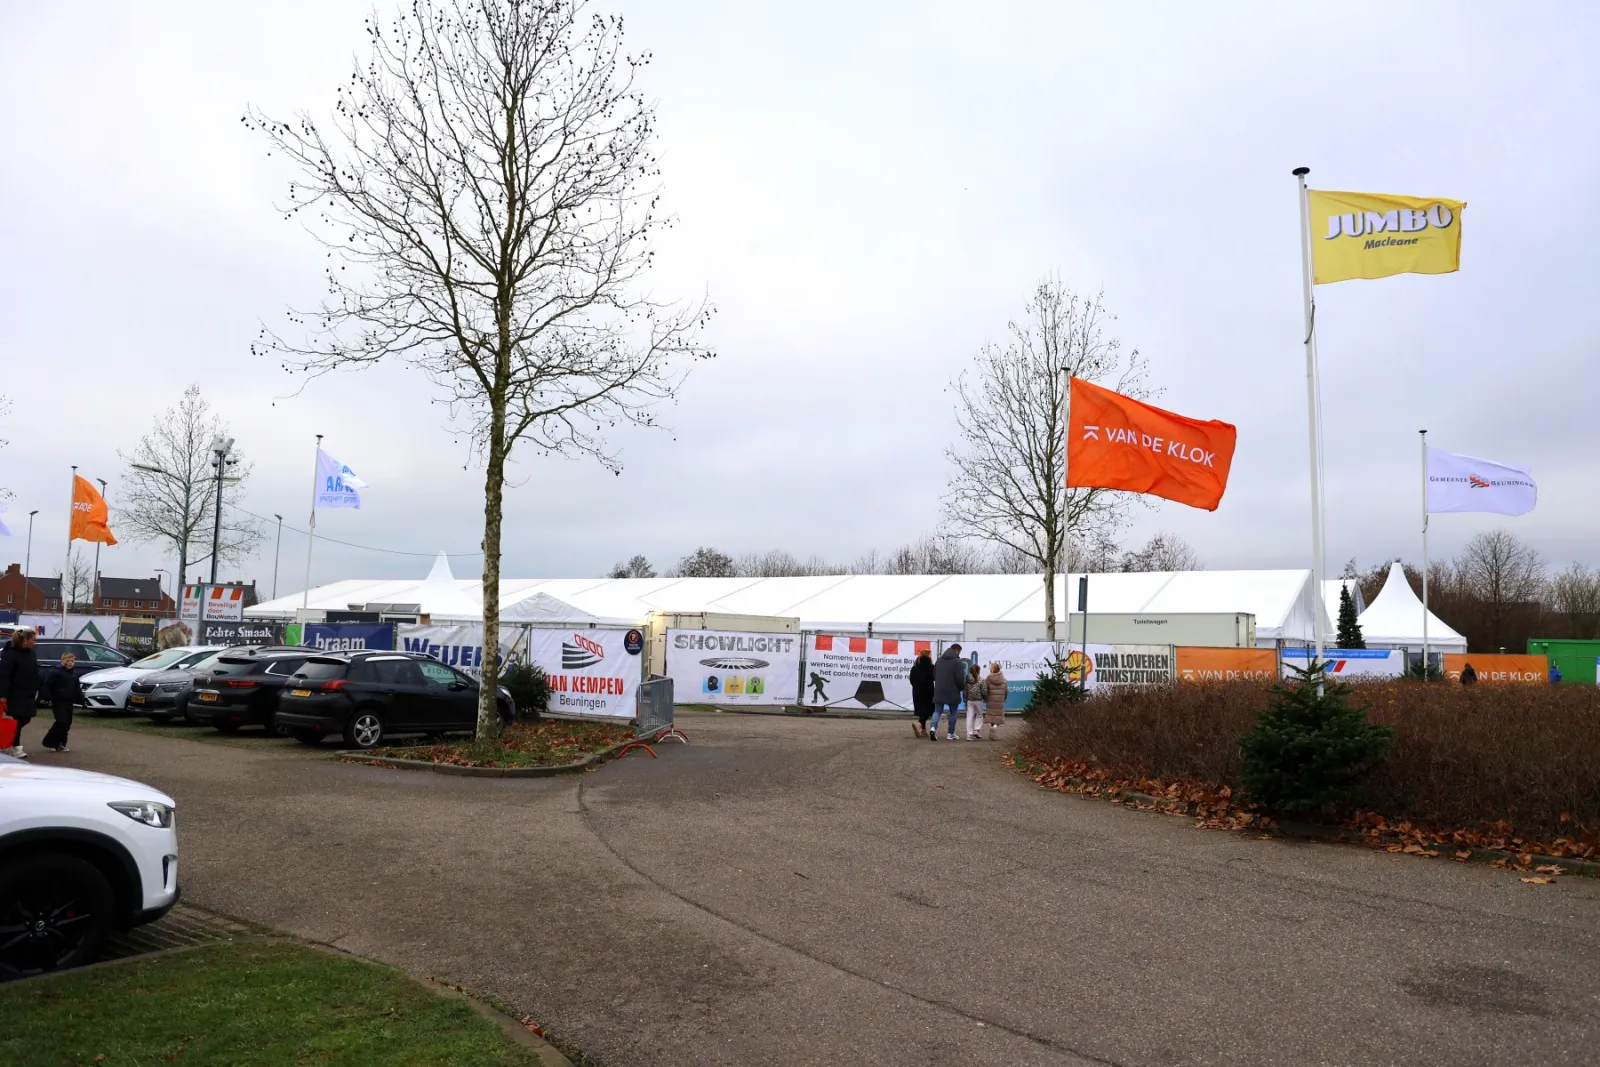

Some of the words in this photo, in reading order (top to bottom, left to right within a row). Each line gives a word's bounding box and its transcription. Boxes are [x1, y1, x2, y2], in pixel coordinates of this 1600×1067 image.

[1324, 203, 1453, 240] JUMBO
[1364, 237, 1418, 249] Macleane
[1106, 428, 1137, 444] VAN
[1142, 434, 1163, 452] DE
[1167, 441, 1215, 467] KLOK
[205, 626, 235, 638] Echte
[237, 626, 272, 638] Smaak
[315, 632, 366, 650] braam
[674, 634, 794, 653] SHOWLIGHT
[823, 653, 853, 662] Namens
[866, 656, 902, 664] Beuningse
[1095, 653, 1118, 668] VAN
[1121, 654, 1168, 669] LOVEREN
[840, 662, 850, 670] wij
[1095, 669, 1169, 683] TANKSTATIONS
[1198, 669, 1223, 681] VAN
[1226, 669, 1240, 681] DE
[1491, 671, 1507, 681] DE
[1509, 671, 1542, 682] KLOK
[572, 676, 624, 695] KEMPEN
[559, 695, 606, 710] Beuningen
